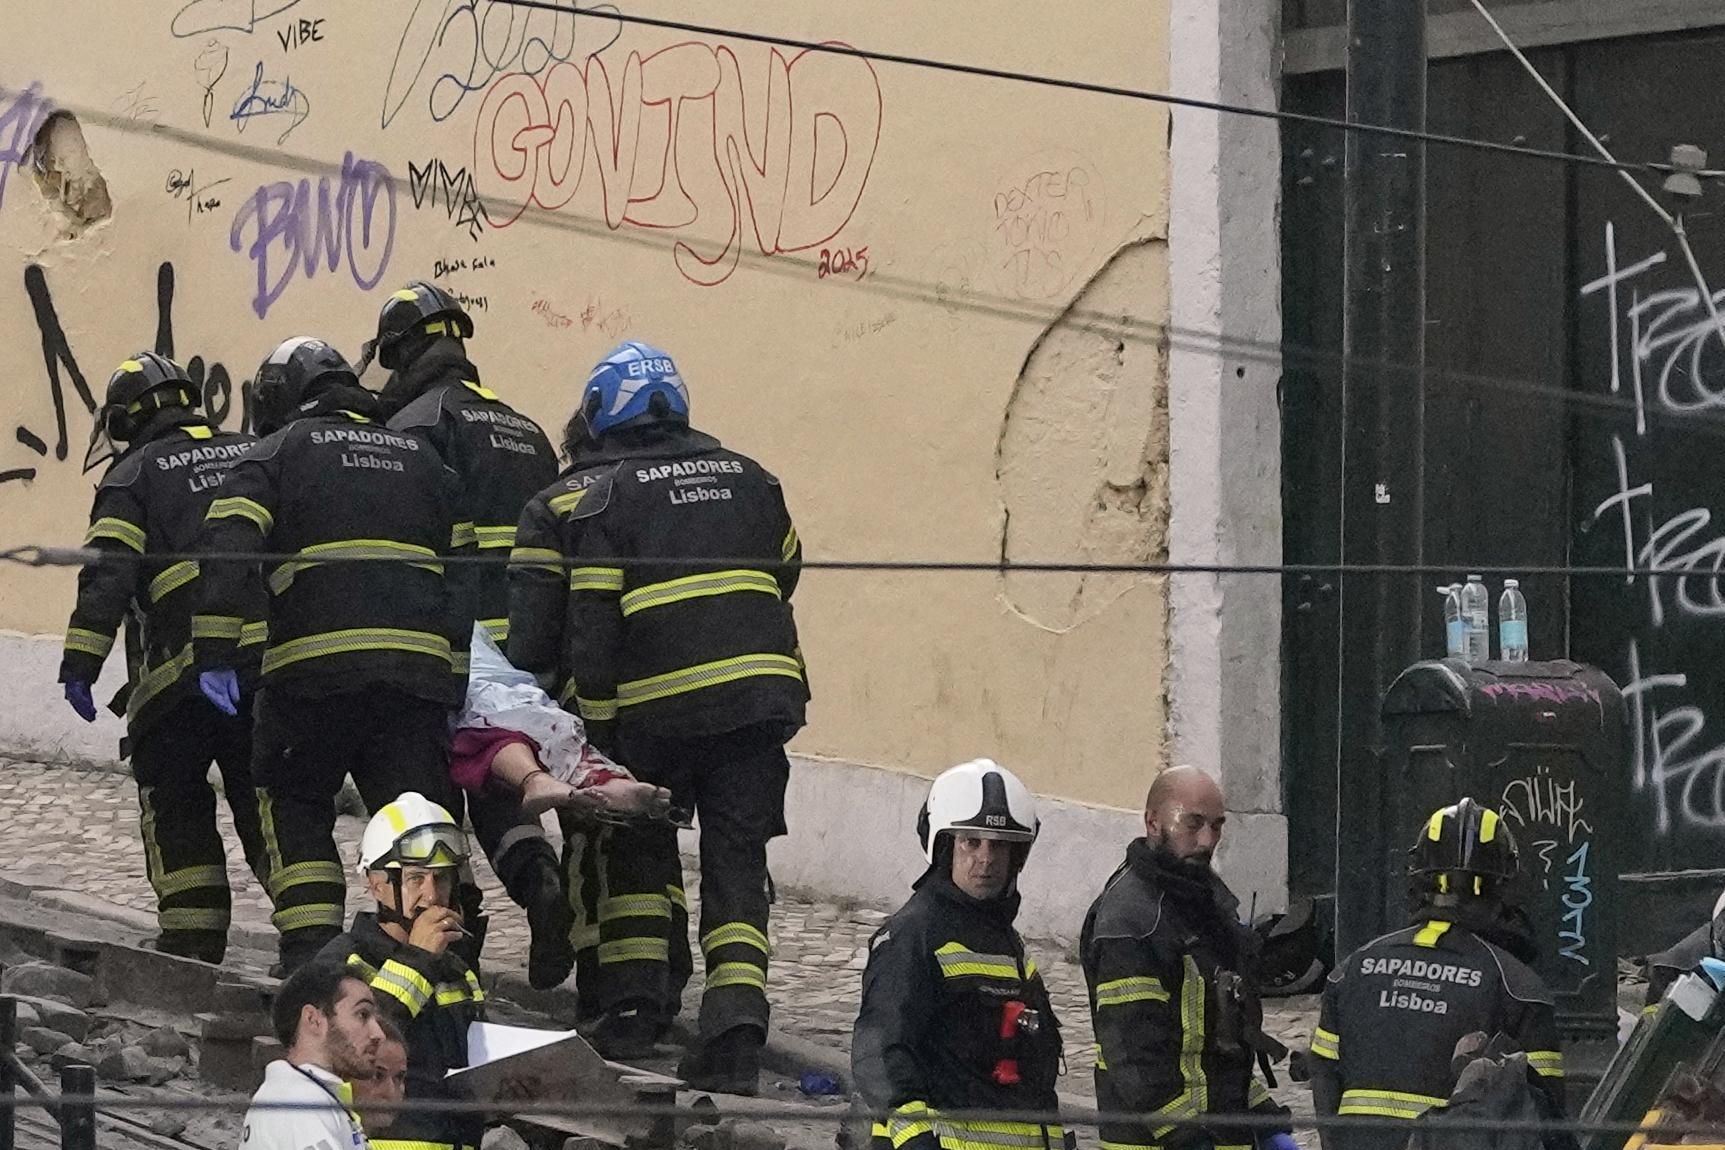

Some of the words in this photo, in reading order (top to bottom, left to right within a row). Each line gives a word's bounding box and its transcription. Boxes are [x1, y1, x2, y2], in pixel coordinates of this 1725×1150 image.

[277, 18, 326, 53] VIBE
[628, 359, 675, 377] ERSB
[310, 430, 420, 451] SAPADORES
[341, 452, 405, 472] Lisboa
[635, 459, 745, 483] SAPADORES
[668, 486, 733, 505] Lisboa
[985, 814, 1007, 827] RSB
[1360, 957, 1482, 987] SAPADORES
[1379, 989, 1449, 1015] Lisboa
